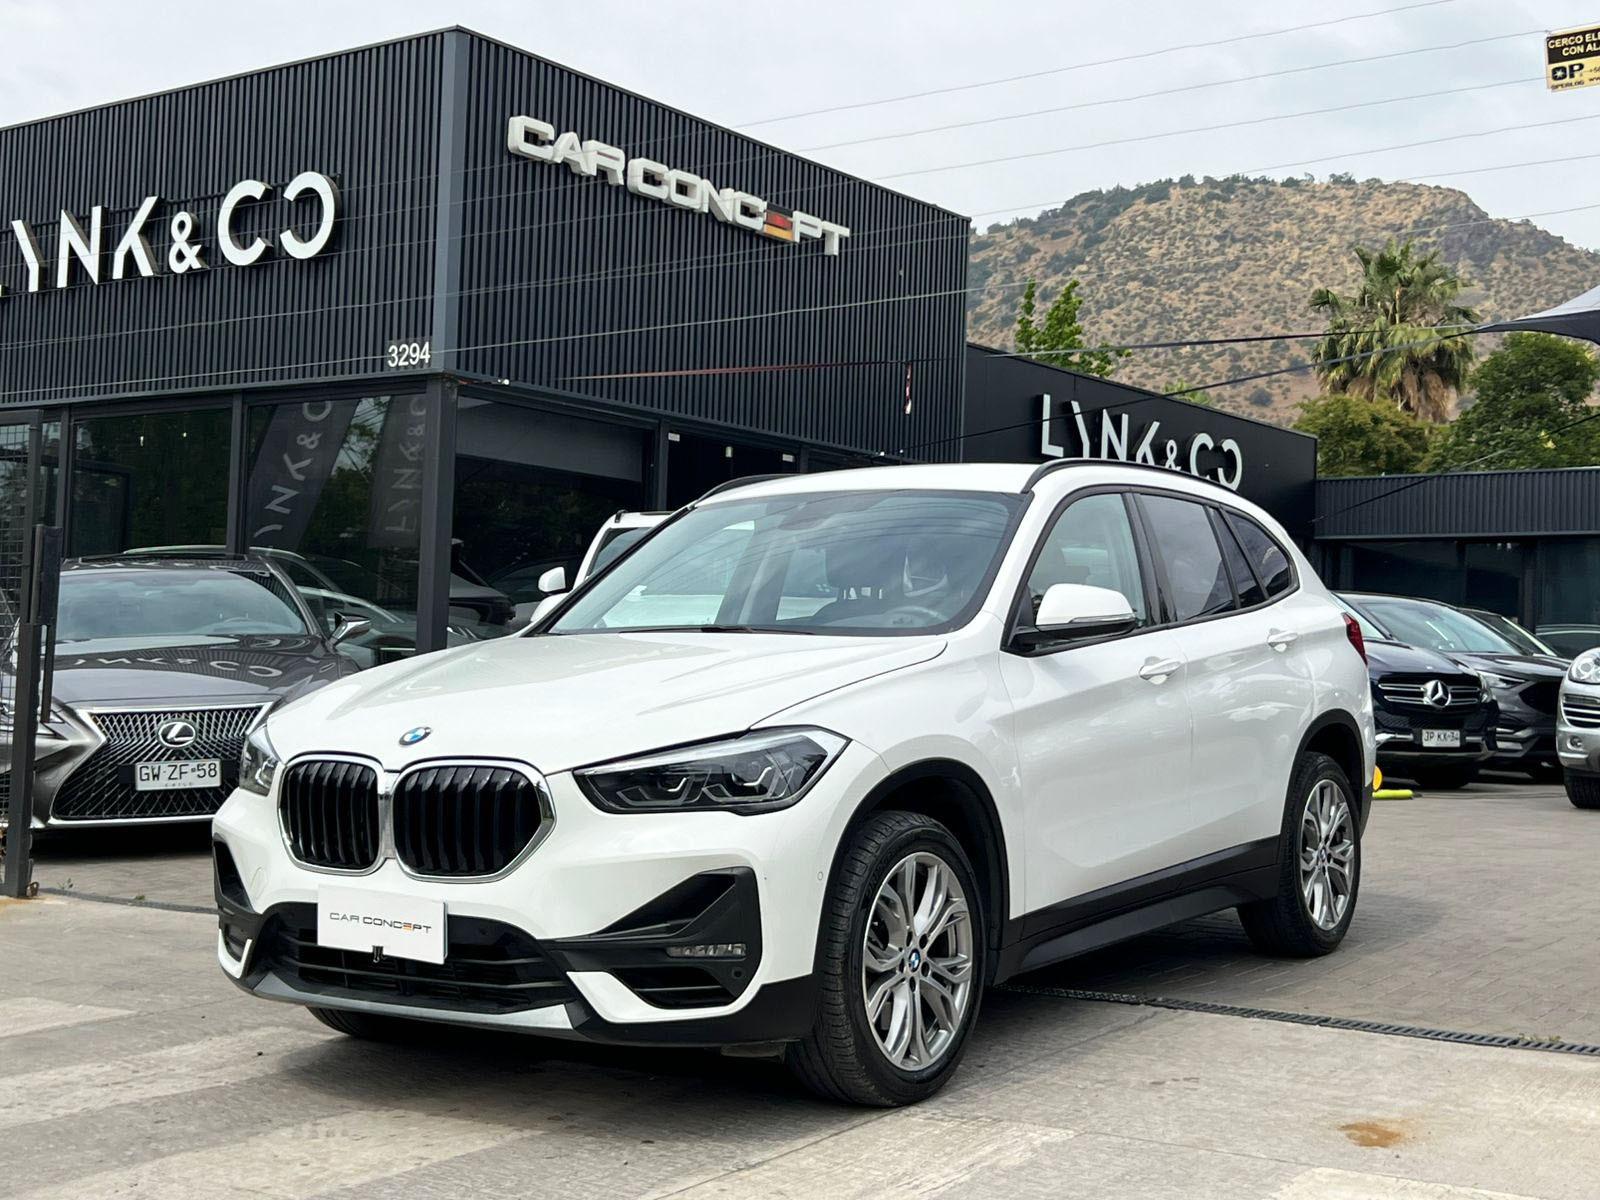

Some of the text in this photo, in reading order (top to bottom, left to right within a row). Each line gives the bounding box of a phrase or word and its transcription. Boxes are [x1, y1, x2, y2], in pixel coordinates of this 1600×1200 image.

[1548, 35, 1583, 48] CERCO
[1562, 45, 1584, 56] CON
[508, 115, 850, 257] CAR CONCEPT
[387, 341, 431, 368] 3294
[329, 912, 432, 934] CAR CONCEPT
